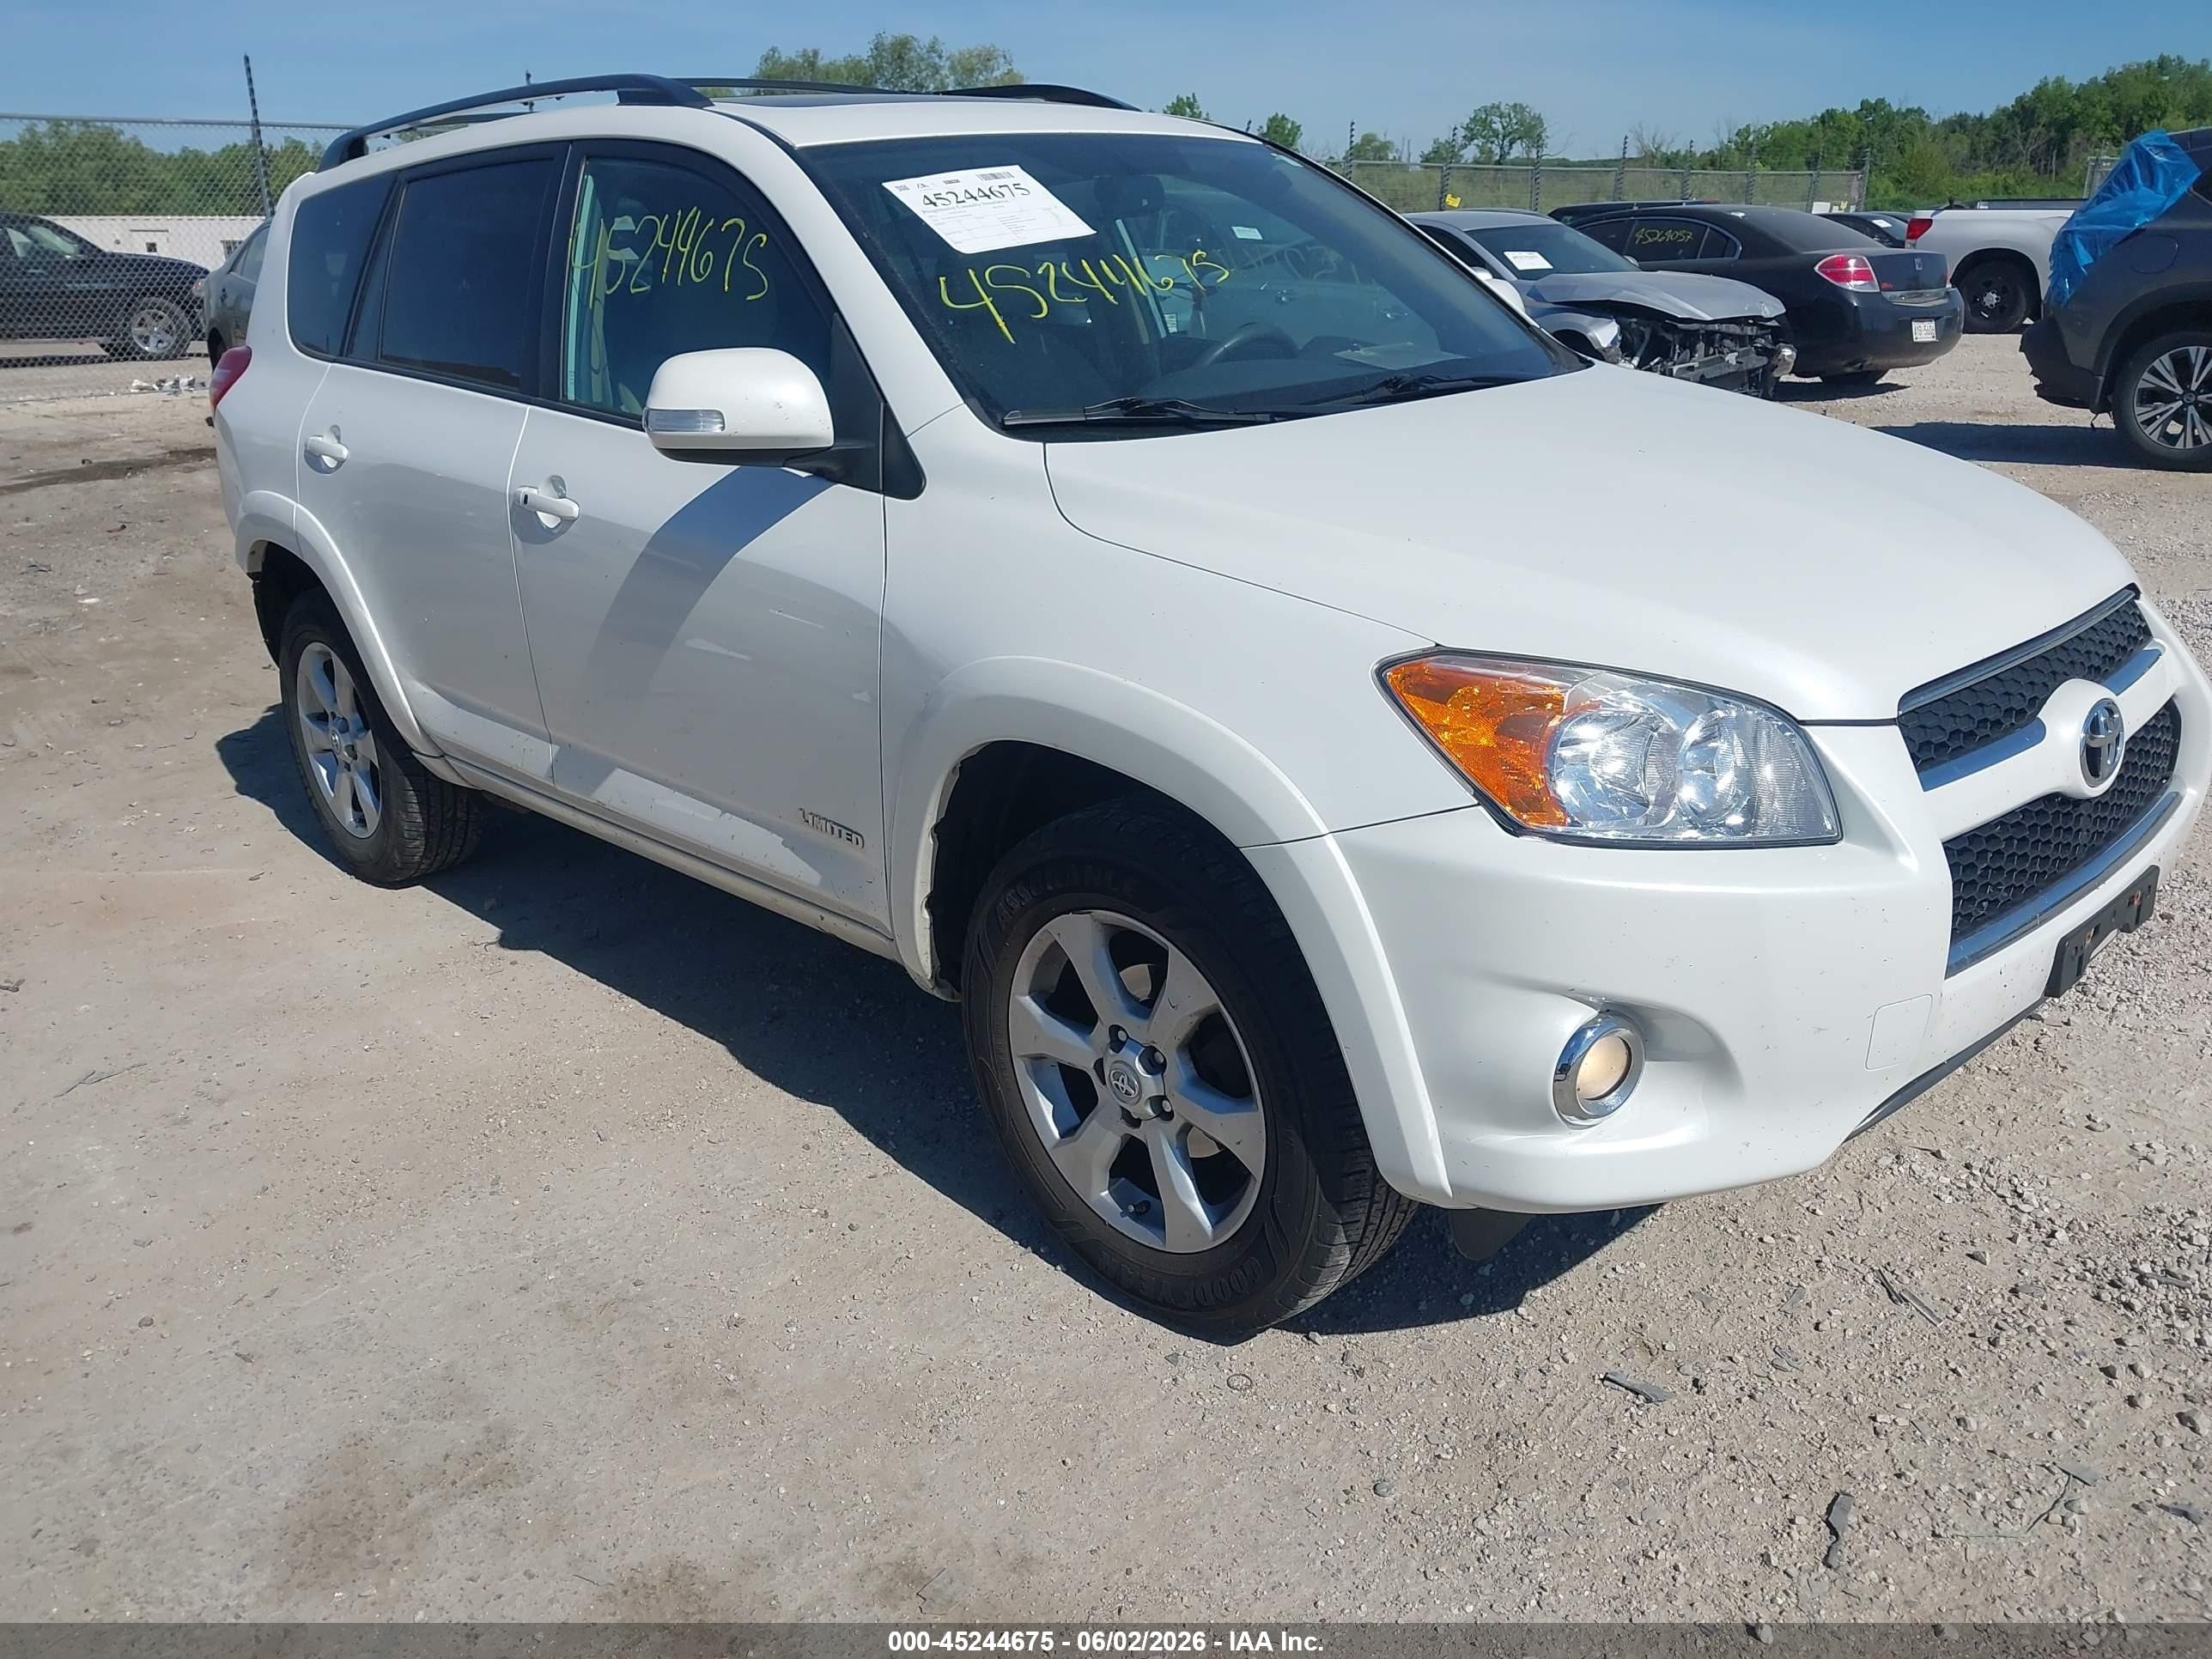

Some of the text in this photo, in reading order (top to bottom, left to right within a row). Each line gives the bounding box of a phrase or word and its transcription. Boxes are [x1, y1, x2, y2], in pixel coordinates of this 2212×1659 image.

[923, 183, 1030, 207] 45244675
[571, 206, 769, 309] 45244675
[939, 250, 1231, 344] 45244675
[799, 807, 865, 849] LIMITED
